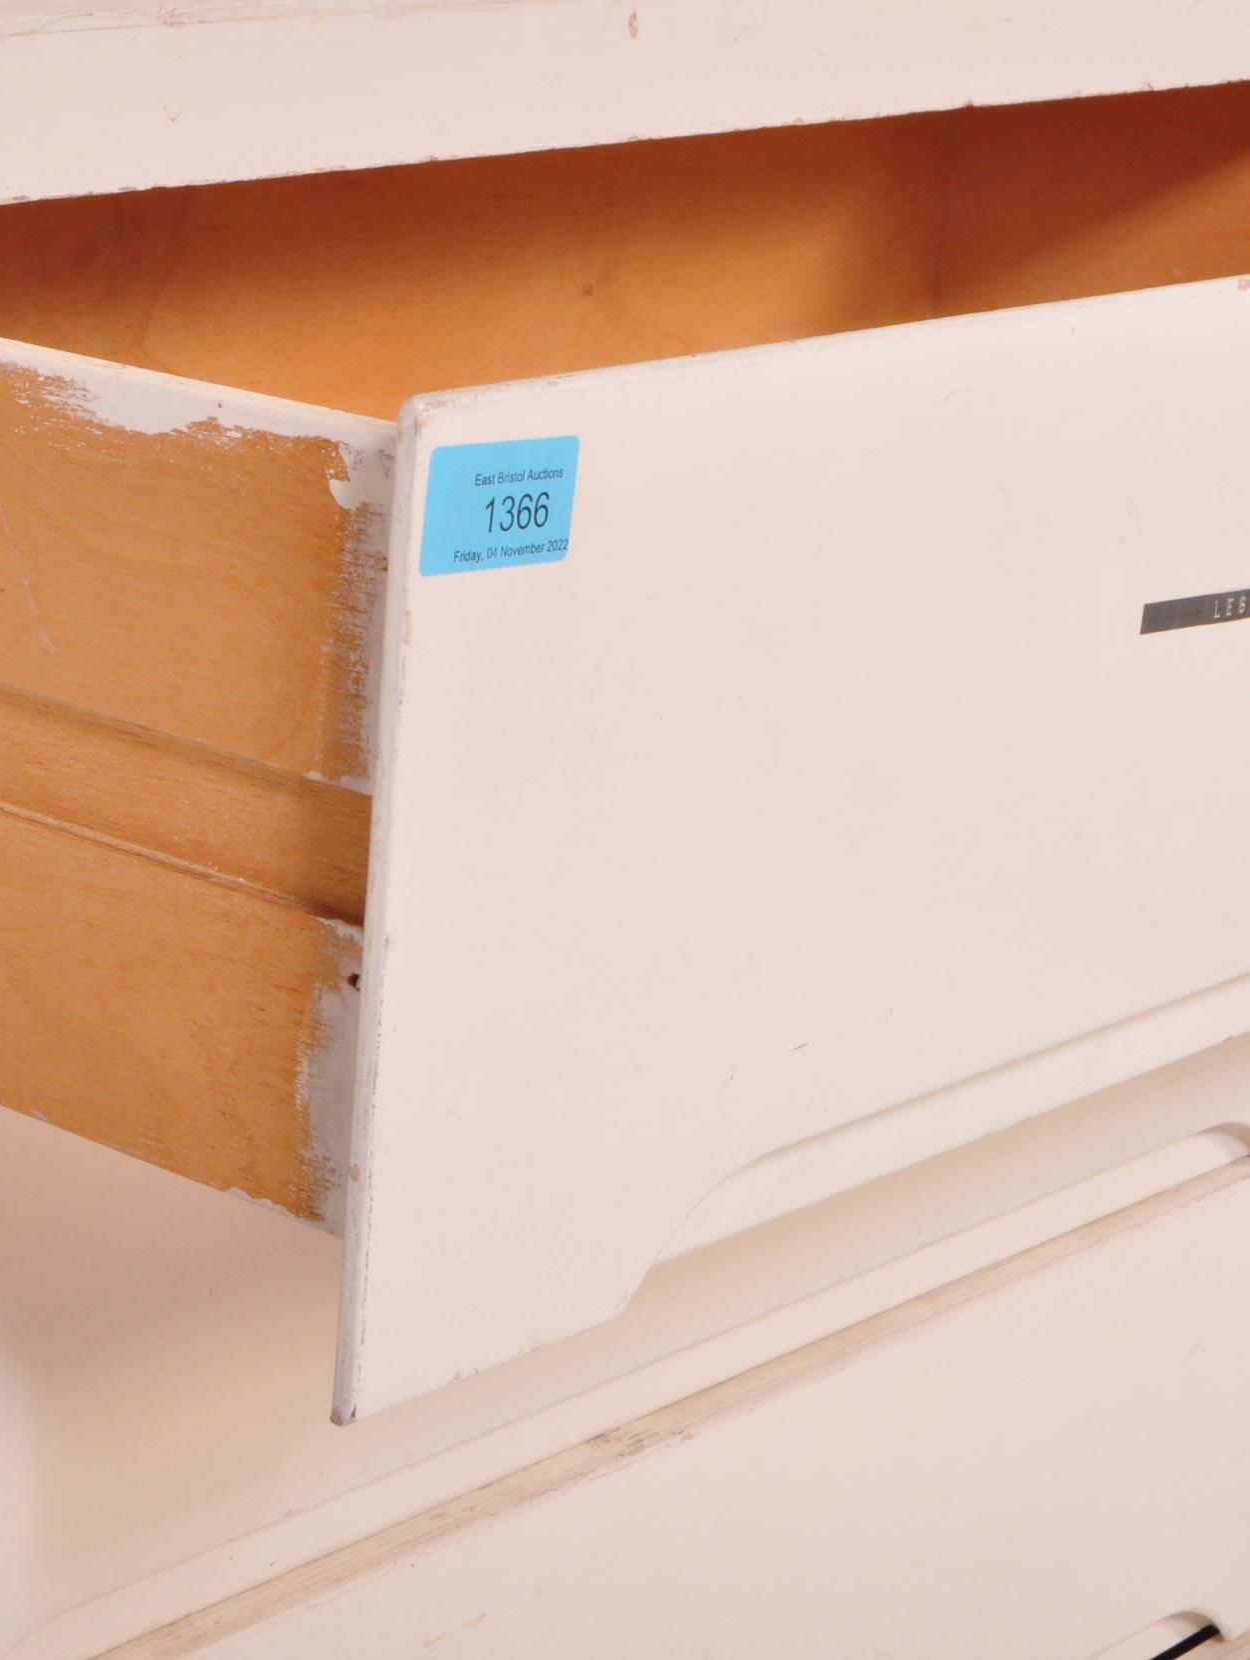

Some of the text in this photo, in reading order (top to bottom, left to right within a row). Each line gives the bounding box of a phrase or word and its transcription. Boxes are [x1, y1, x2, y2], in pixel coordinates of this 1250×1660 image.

[474, 467, 564, 486] East Bristol Auctions
[485, 491, 550, 533] 1366
[453, 538, 568, 563] Friday, 04 November 2022
